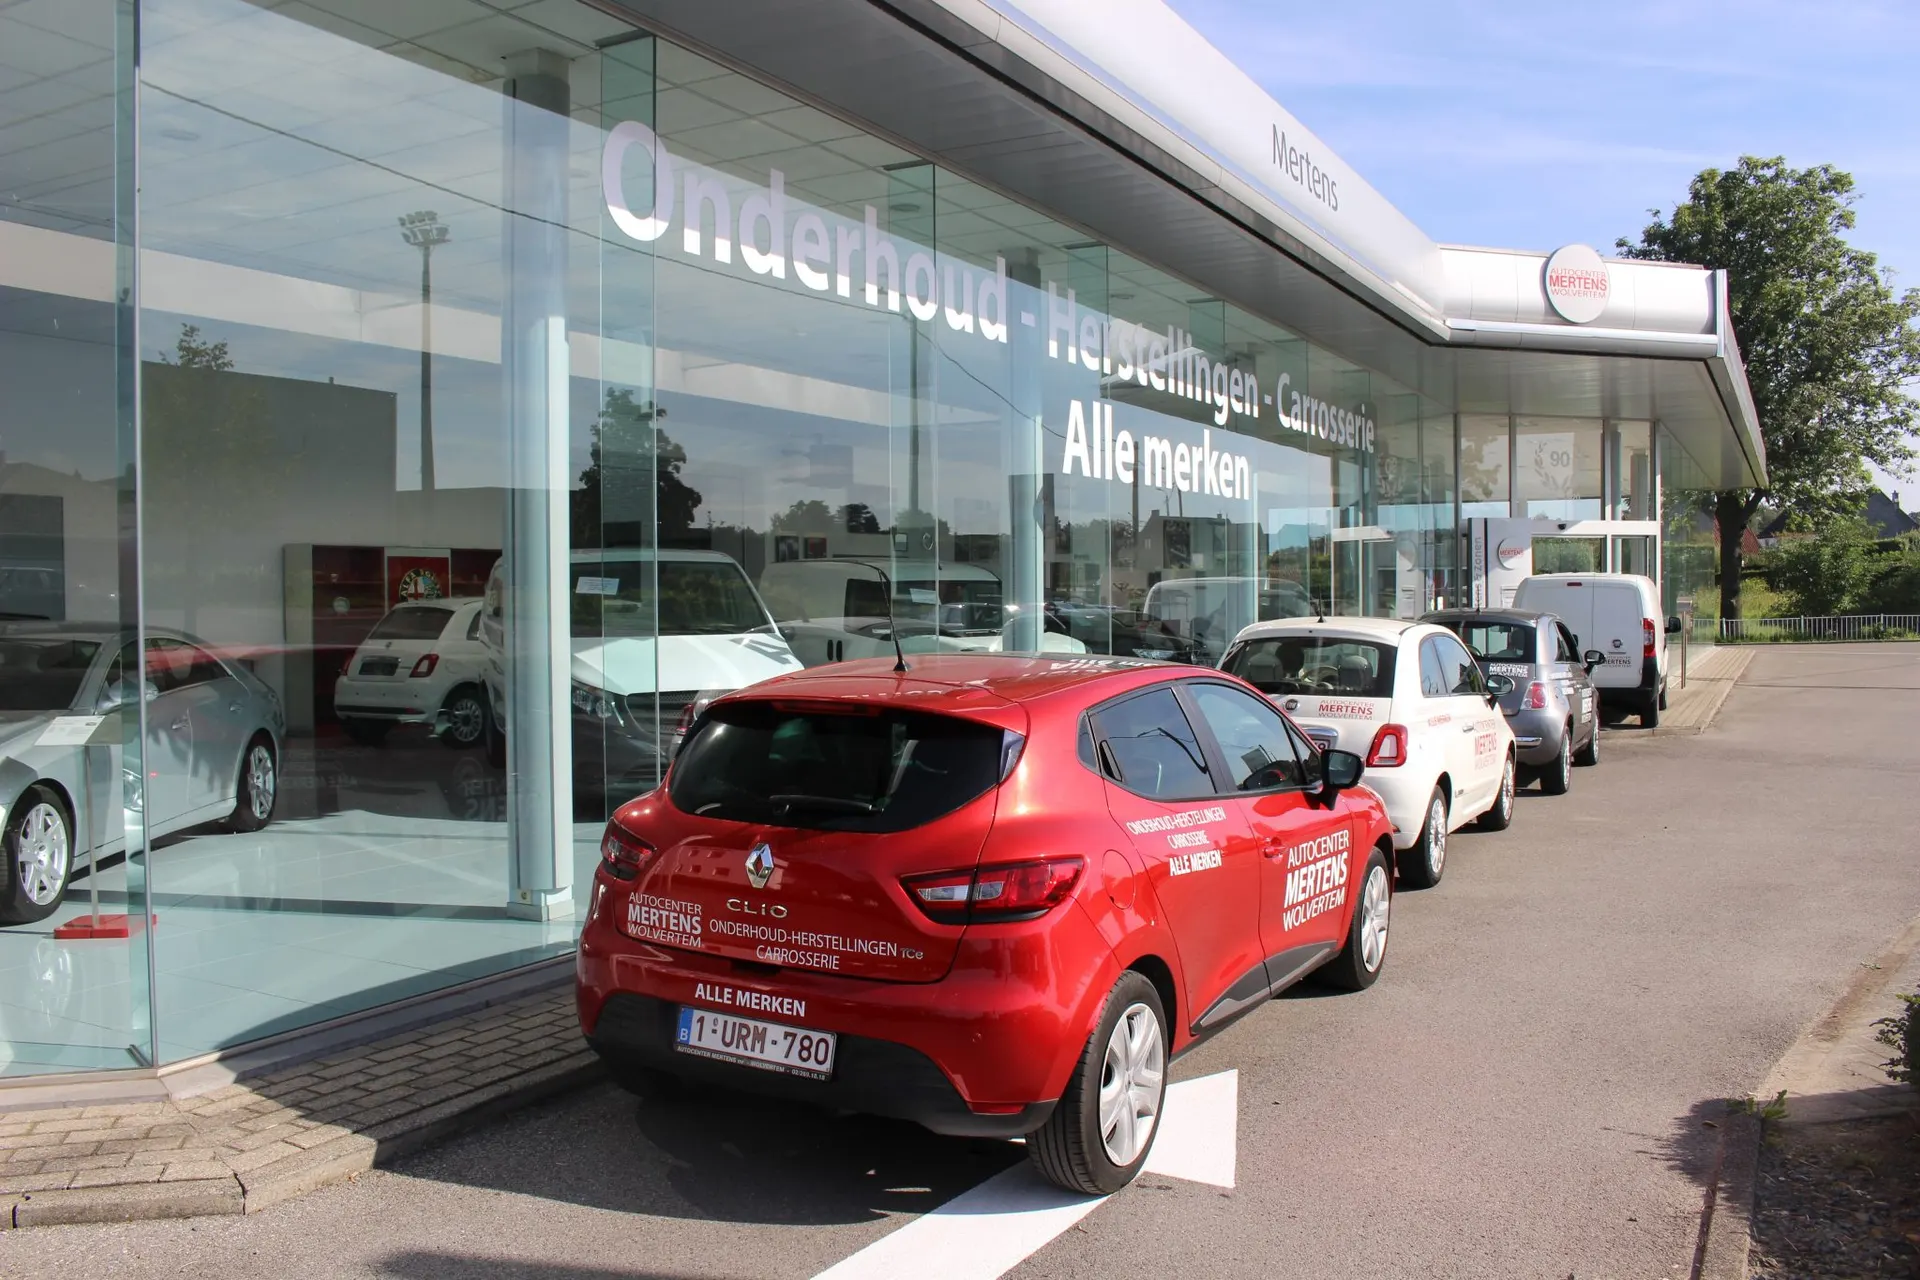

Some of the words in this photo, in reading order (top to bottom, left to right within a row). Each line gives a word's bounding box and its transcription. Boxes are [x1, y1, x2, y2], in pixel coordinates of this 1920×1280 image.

[1272, 123, 1339, 212] Mertens
[1549, 275, 1607, 291] MERTENS
[1550, 268, 1606, 278] AUTOCENTER
[602, 120, 1007, 343] Onderhoud
[1021, 310, 1036, 328] -
[1048, 280, 1260, 426] Herstellingen
[1277, 372, 1375, 453] Carrosserie
[1550, 288, 1606, 299] WOLVERTEM
[1062, 400, 1135, 484] Alle
[1144, 429, 1250, 500] merken
[1550, 450, 1570, 468] 90
[1489, 666, 1528, 674] MERTENS
[1318, 704, 1373, 716] MERTENS
[1320, 699, 1375, 708] AUTOCENTER
[1318, 713, 1373, 721] WOLVERTEM
[1126, 806, 1227, 835] ONDERHOUD-HERSTELLINGEN
[1166, 830, 1210, 849] CARROSSERIE
[1287, 830, 1349, 869] AUTOCENTER
[1169, 854, 1191, 876] ALLE
[1190, 849, 1222, 872] MERKEN
[1283, 852, 1349, 909] MERTENS
[628, 891, 702, 915] AUTOCENTER
[726, 898, 788, 919] CLIO
[1283, 886, 1345, 932] WOLVERTEM
[627, 903, 702, 935] MERTENS
[627, 922, 701, 948] WOLVERTEM
[709, 919, 898, 957] ONDERHOUD-HERSTELLINGEN
[756, 945, 841, 970] CARROSSERIE
[900, 948, 924, 960] TCe
[695, 983, 733, 1005] ALLE
[736, 989, 807, 1017] MERKEN
[679, 1028, 689, 1041] B
[677, 1046, 711, 1058] AUTOCENTER
[711, 1053, 737, 1063] MERTENS
[750, 1060, 785, 1072] WOLVERTEM
